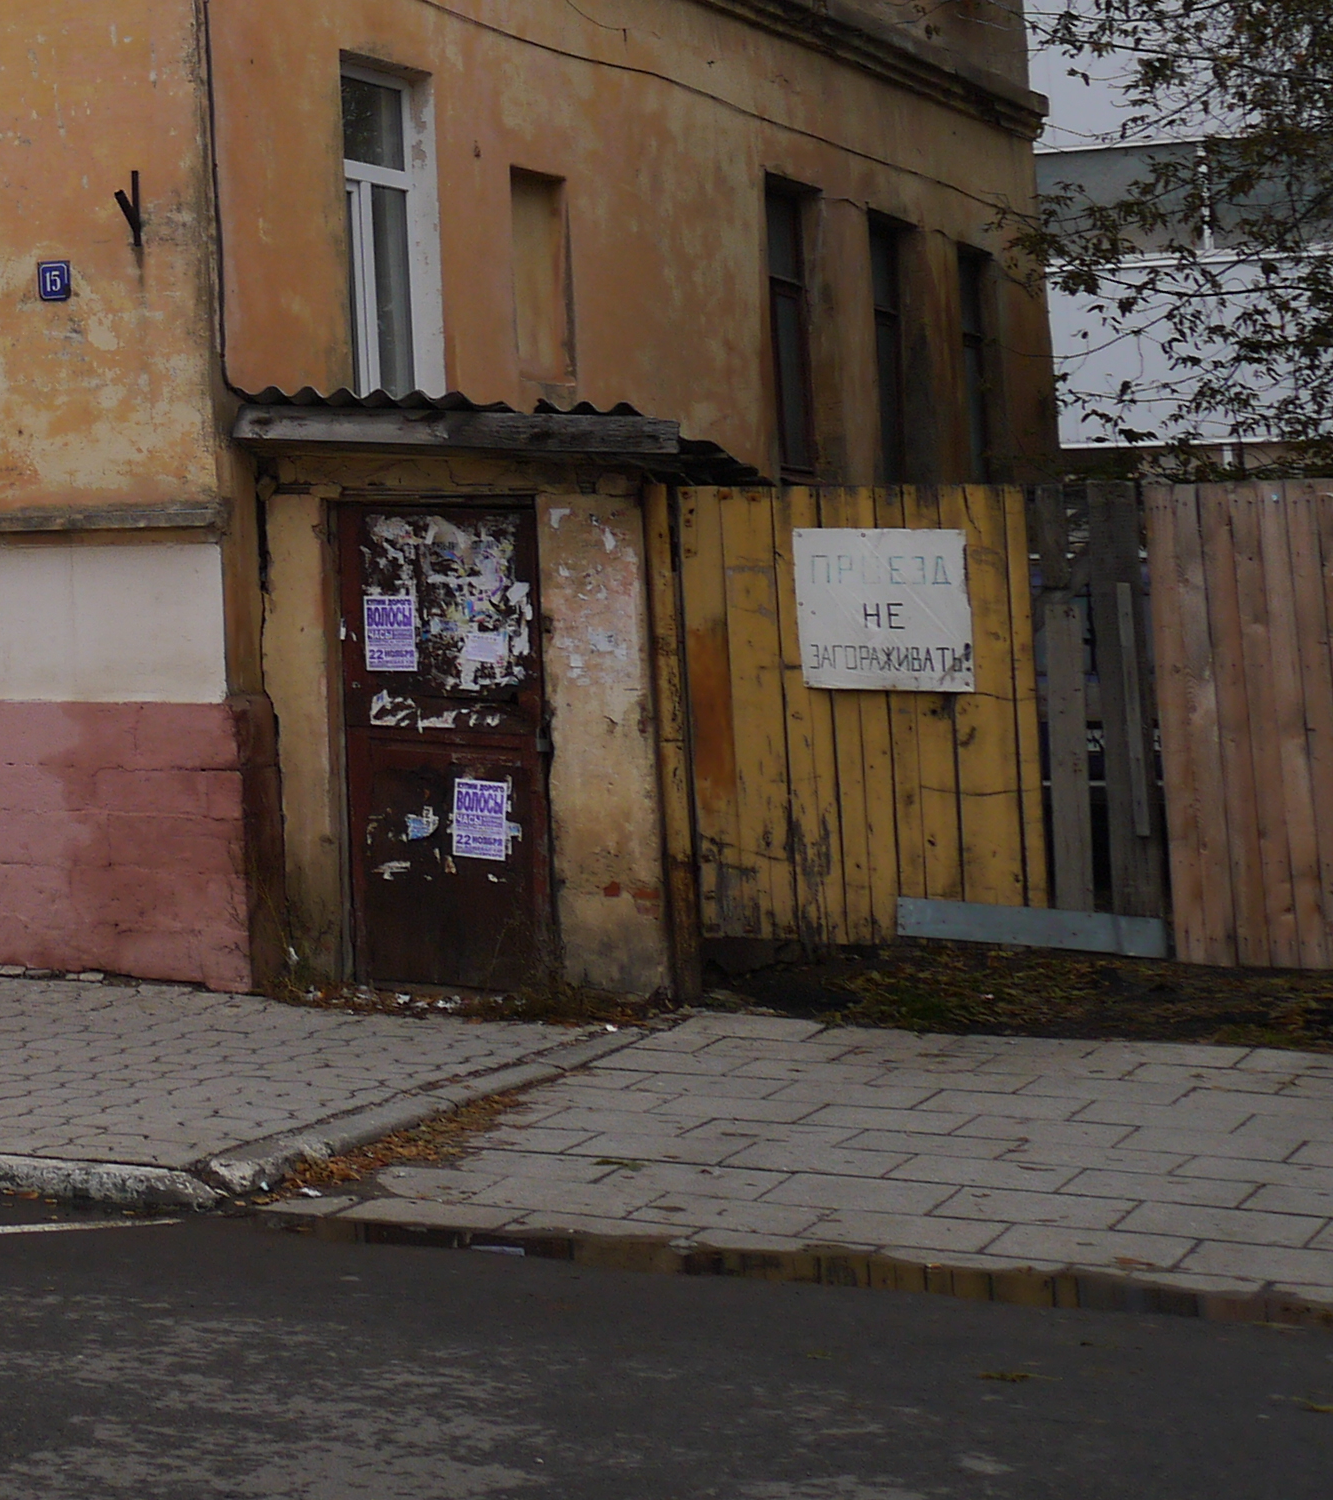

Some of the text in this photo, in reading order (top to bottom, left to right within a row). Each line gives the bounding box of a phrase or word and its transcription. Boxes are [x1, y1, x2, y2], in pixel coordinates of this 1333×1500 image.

[45, 270, 61, 292] 15
[811, 554, 952, 585] ПРОЕЗД
[366, 606, 413, 628] ВОЛОСЫ
[863, 602, 906, 630] НЕ
[368, 649, 384, 660] 22
[810, 642, 971, 673] ЗАГОРАЖИВАТЬ!
[456, 790, 504, 814] ВОЛОСЫ
[456, 833, 471, 845] 22
